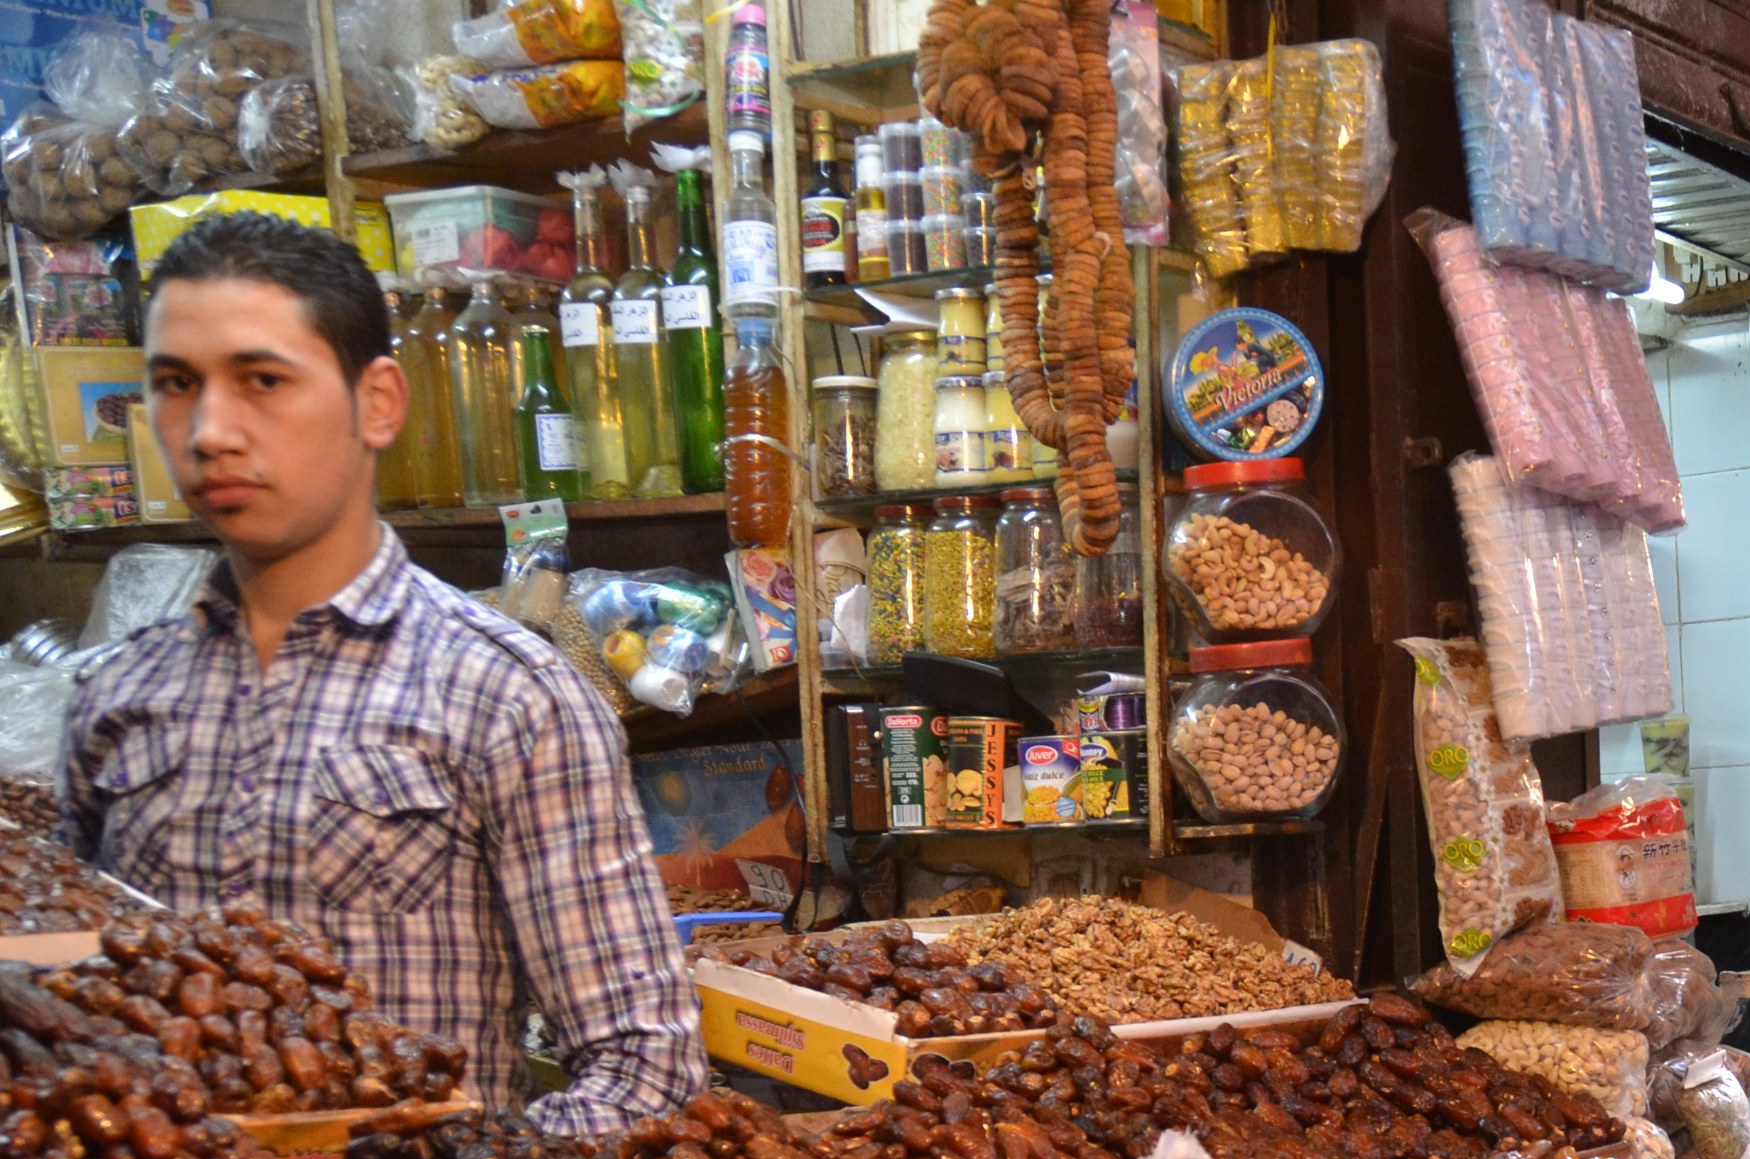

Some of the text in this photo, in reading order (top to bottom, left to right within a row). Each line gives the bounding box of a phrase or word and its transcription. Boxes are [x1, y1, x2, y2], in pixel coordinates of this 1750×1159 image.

[1215, 367, 1283, 412] Victoria
[703, 752, 768, 777] Standard
[1028, 749, 1054, 762] Juver
[1429, 746, 1471, 768] ORO
[1040, 770, 1065, 780] dulce
[1444, 840, 1486, 859] ORO
[750, 865, 786, 890] 90
[1452, 930, 1493, 950] ORO
[747, 1040, 795, 1075] Dattes
